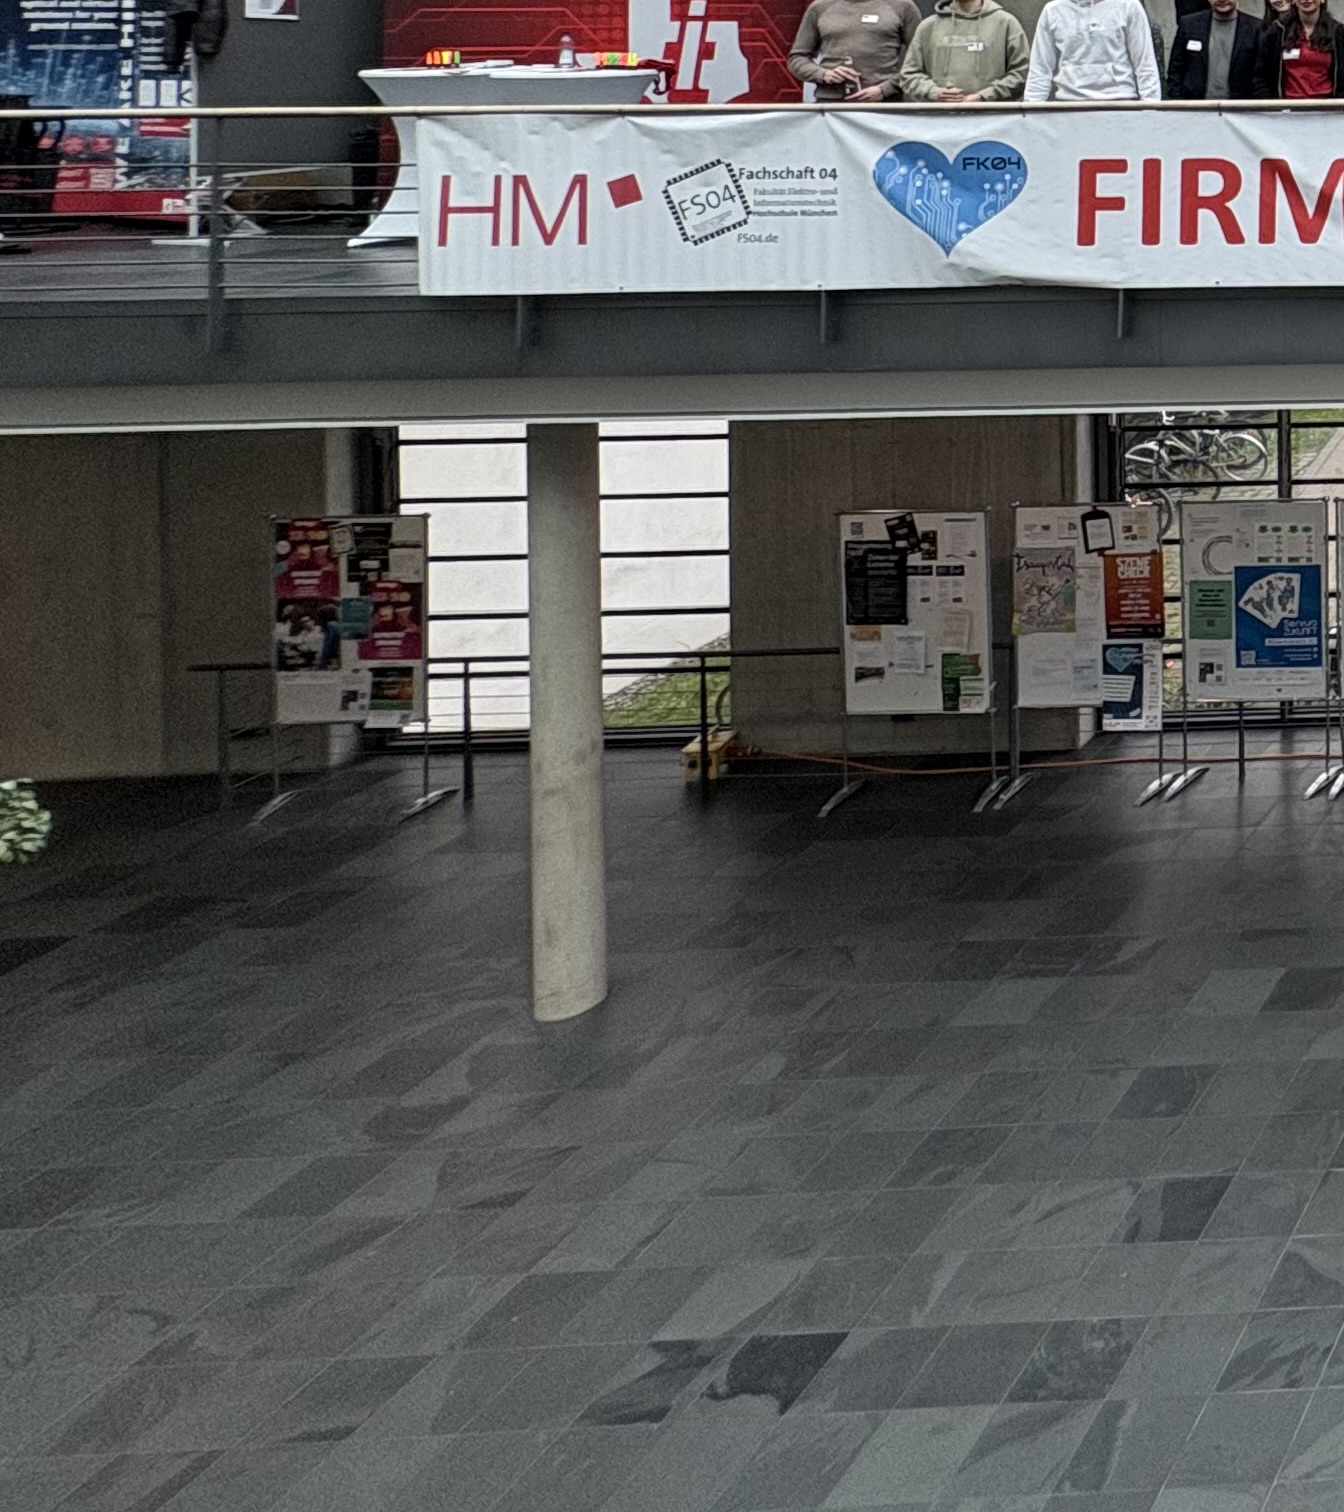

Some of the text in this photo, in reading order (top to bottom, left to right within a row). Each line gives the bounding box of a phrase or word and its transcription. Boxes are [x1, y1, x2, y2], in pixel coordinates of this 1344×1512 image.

[738, 166, 839, 180] Fachschaft 04
[961, 156, 1022, 171] FK04
[437, 173, 588, 247] HM
[677, 184, 737, 221] FS04
